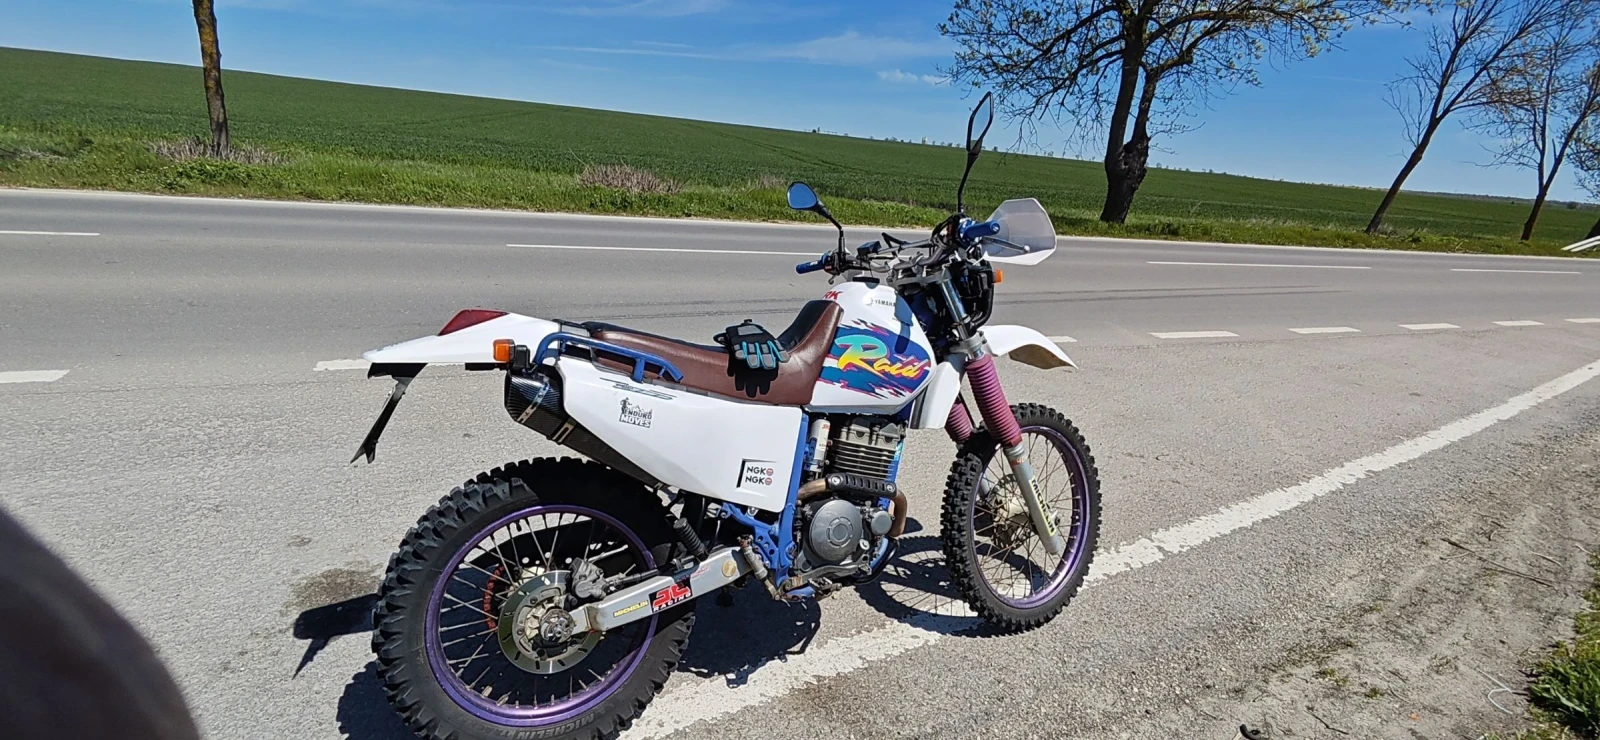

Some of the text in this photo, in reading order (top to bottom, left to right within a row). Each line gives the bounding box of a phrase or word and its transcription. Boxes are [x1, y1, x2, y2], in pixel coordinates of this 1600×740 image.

[835, 334, 929, 380] Raid
[620, 414, 651, 428] MOVES
[745, 475, 765, 485] NGK
[746, 466, 766, 476] NGK
[1031, 479, 1056, 533] MICHELIN
[613, 600, 649, 618] MICHELIN
[653, 592, 692, 613] RACING
[517, 712, 595, 740] MICHELIN
